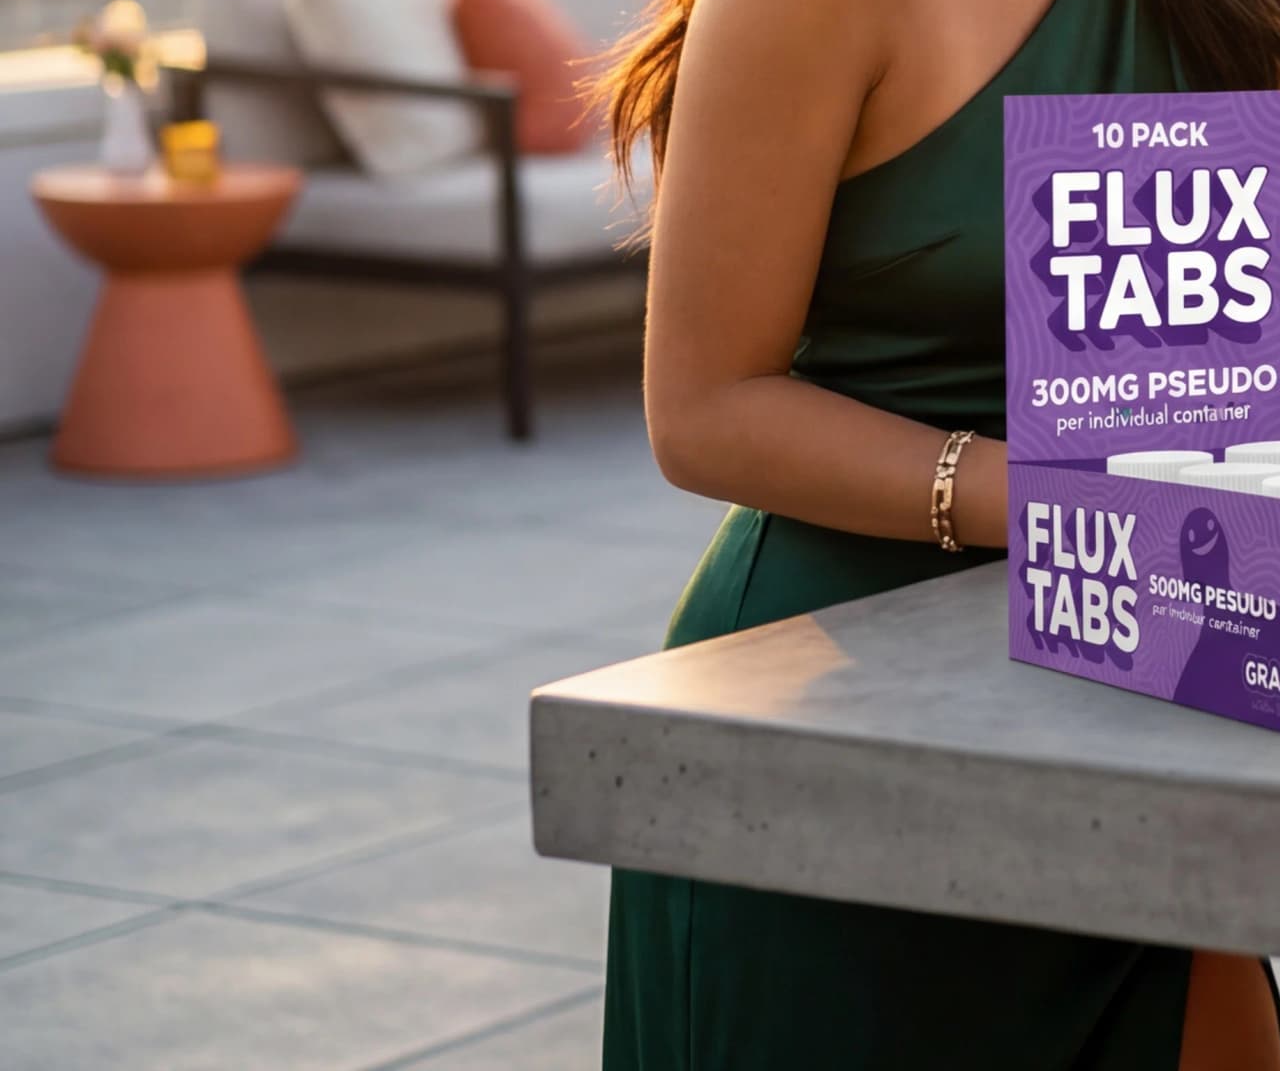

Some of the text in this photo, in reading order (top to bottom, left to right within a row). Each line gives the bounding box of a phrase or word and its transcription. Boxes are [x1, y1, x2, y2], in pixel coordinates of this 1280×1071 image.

[1092, 122, 1208, 148] 10 PACK
[1050, 166, 1271, 248] FLUX
[1049, 246, 1273, 331] TABS
[1031, 364, 1277, 407] 300MG PSEUDO
[1057, 415, 1083, 436] per
[1027, 501, 1137, 580] FLUX
[1027, 567, 1140, 653] TABS
